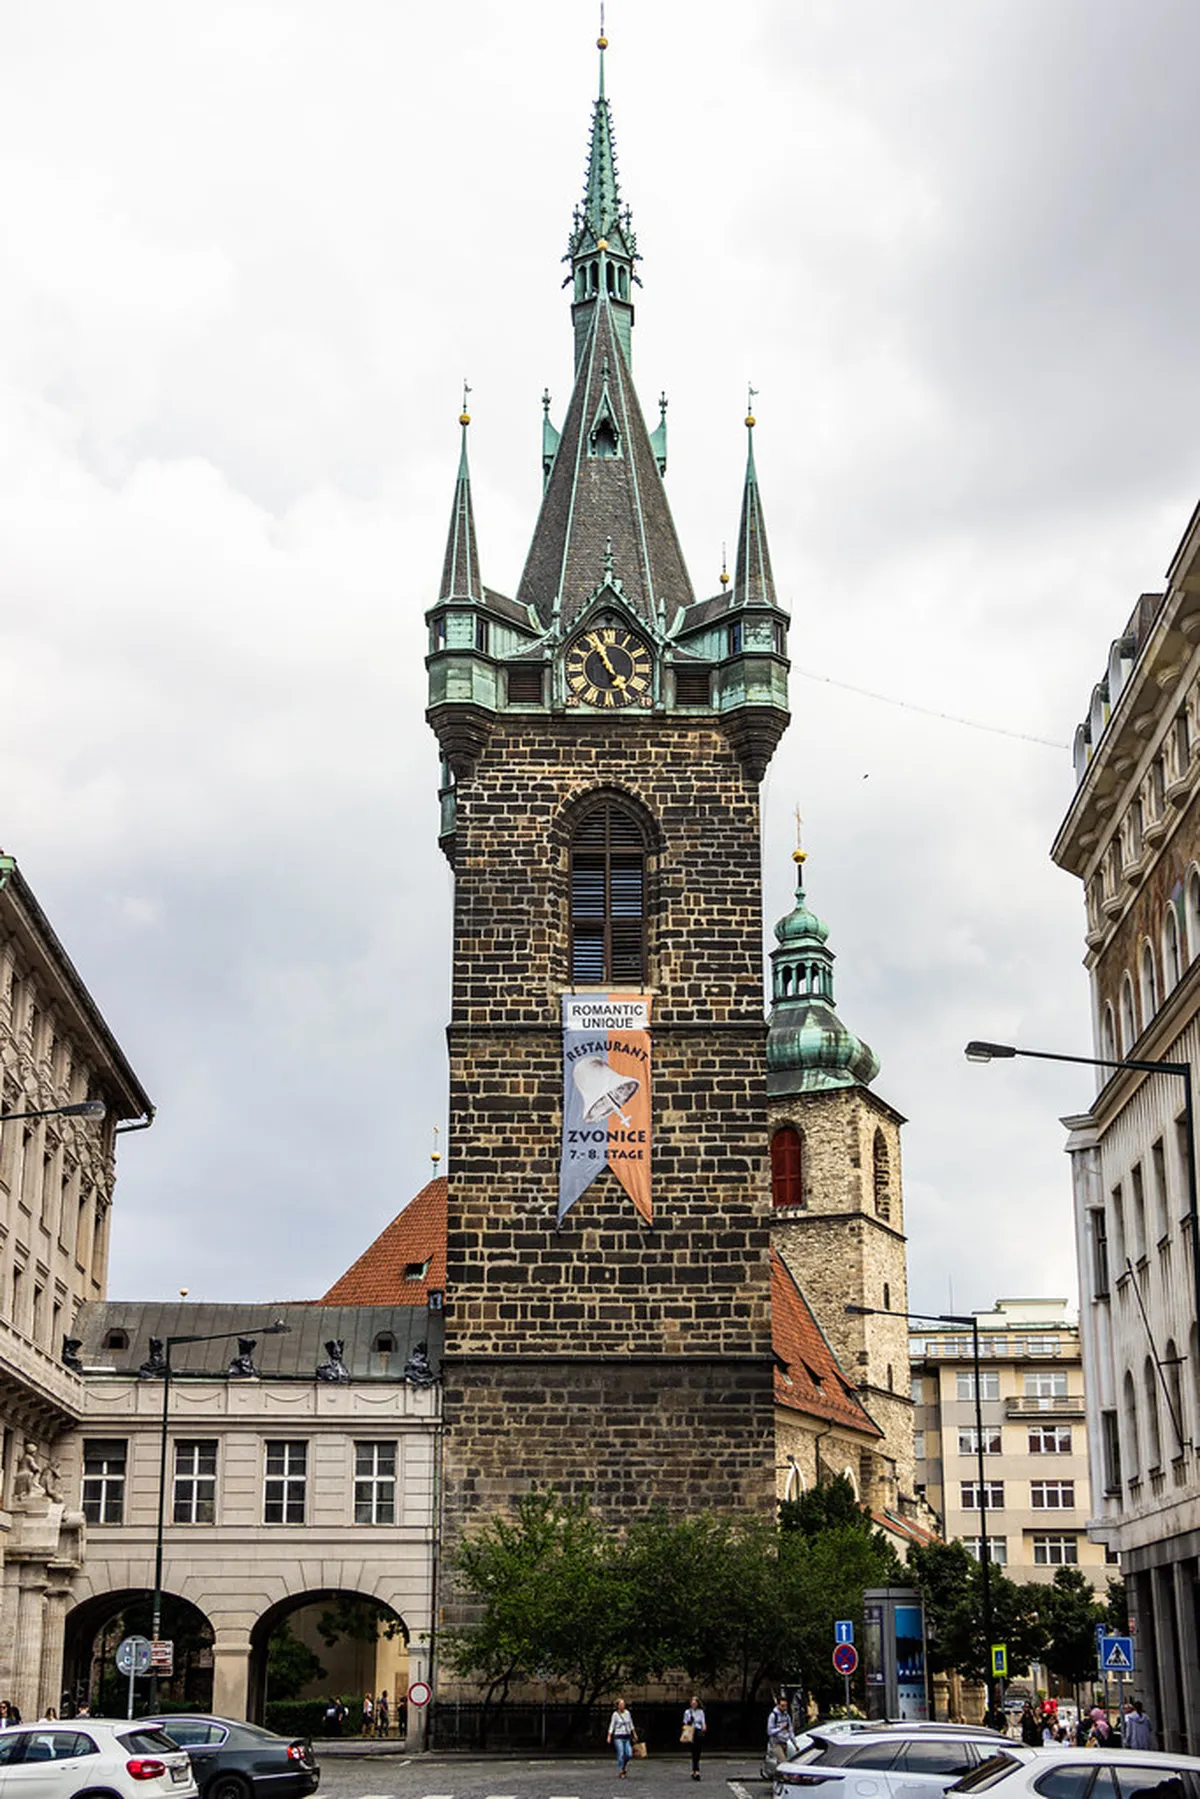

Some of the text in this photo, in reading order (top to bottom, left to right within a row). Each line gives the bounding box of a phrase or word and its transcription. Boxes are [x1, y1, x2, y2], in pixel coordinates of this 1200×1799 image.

[572, 1004, 644, 1016] ROMANTIC
[582, 1017, 633, 1029] UNIQUE
[566, 1040, 649, 1062] RESTAURANT
[568, 1130, 646, 1143] ZVONICE
[604, 1150, 644, 1160] ETAGE
